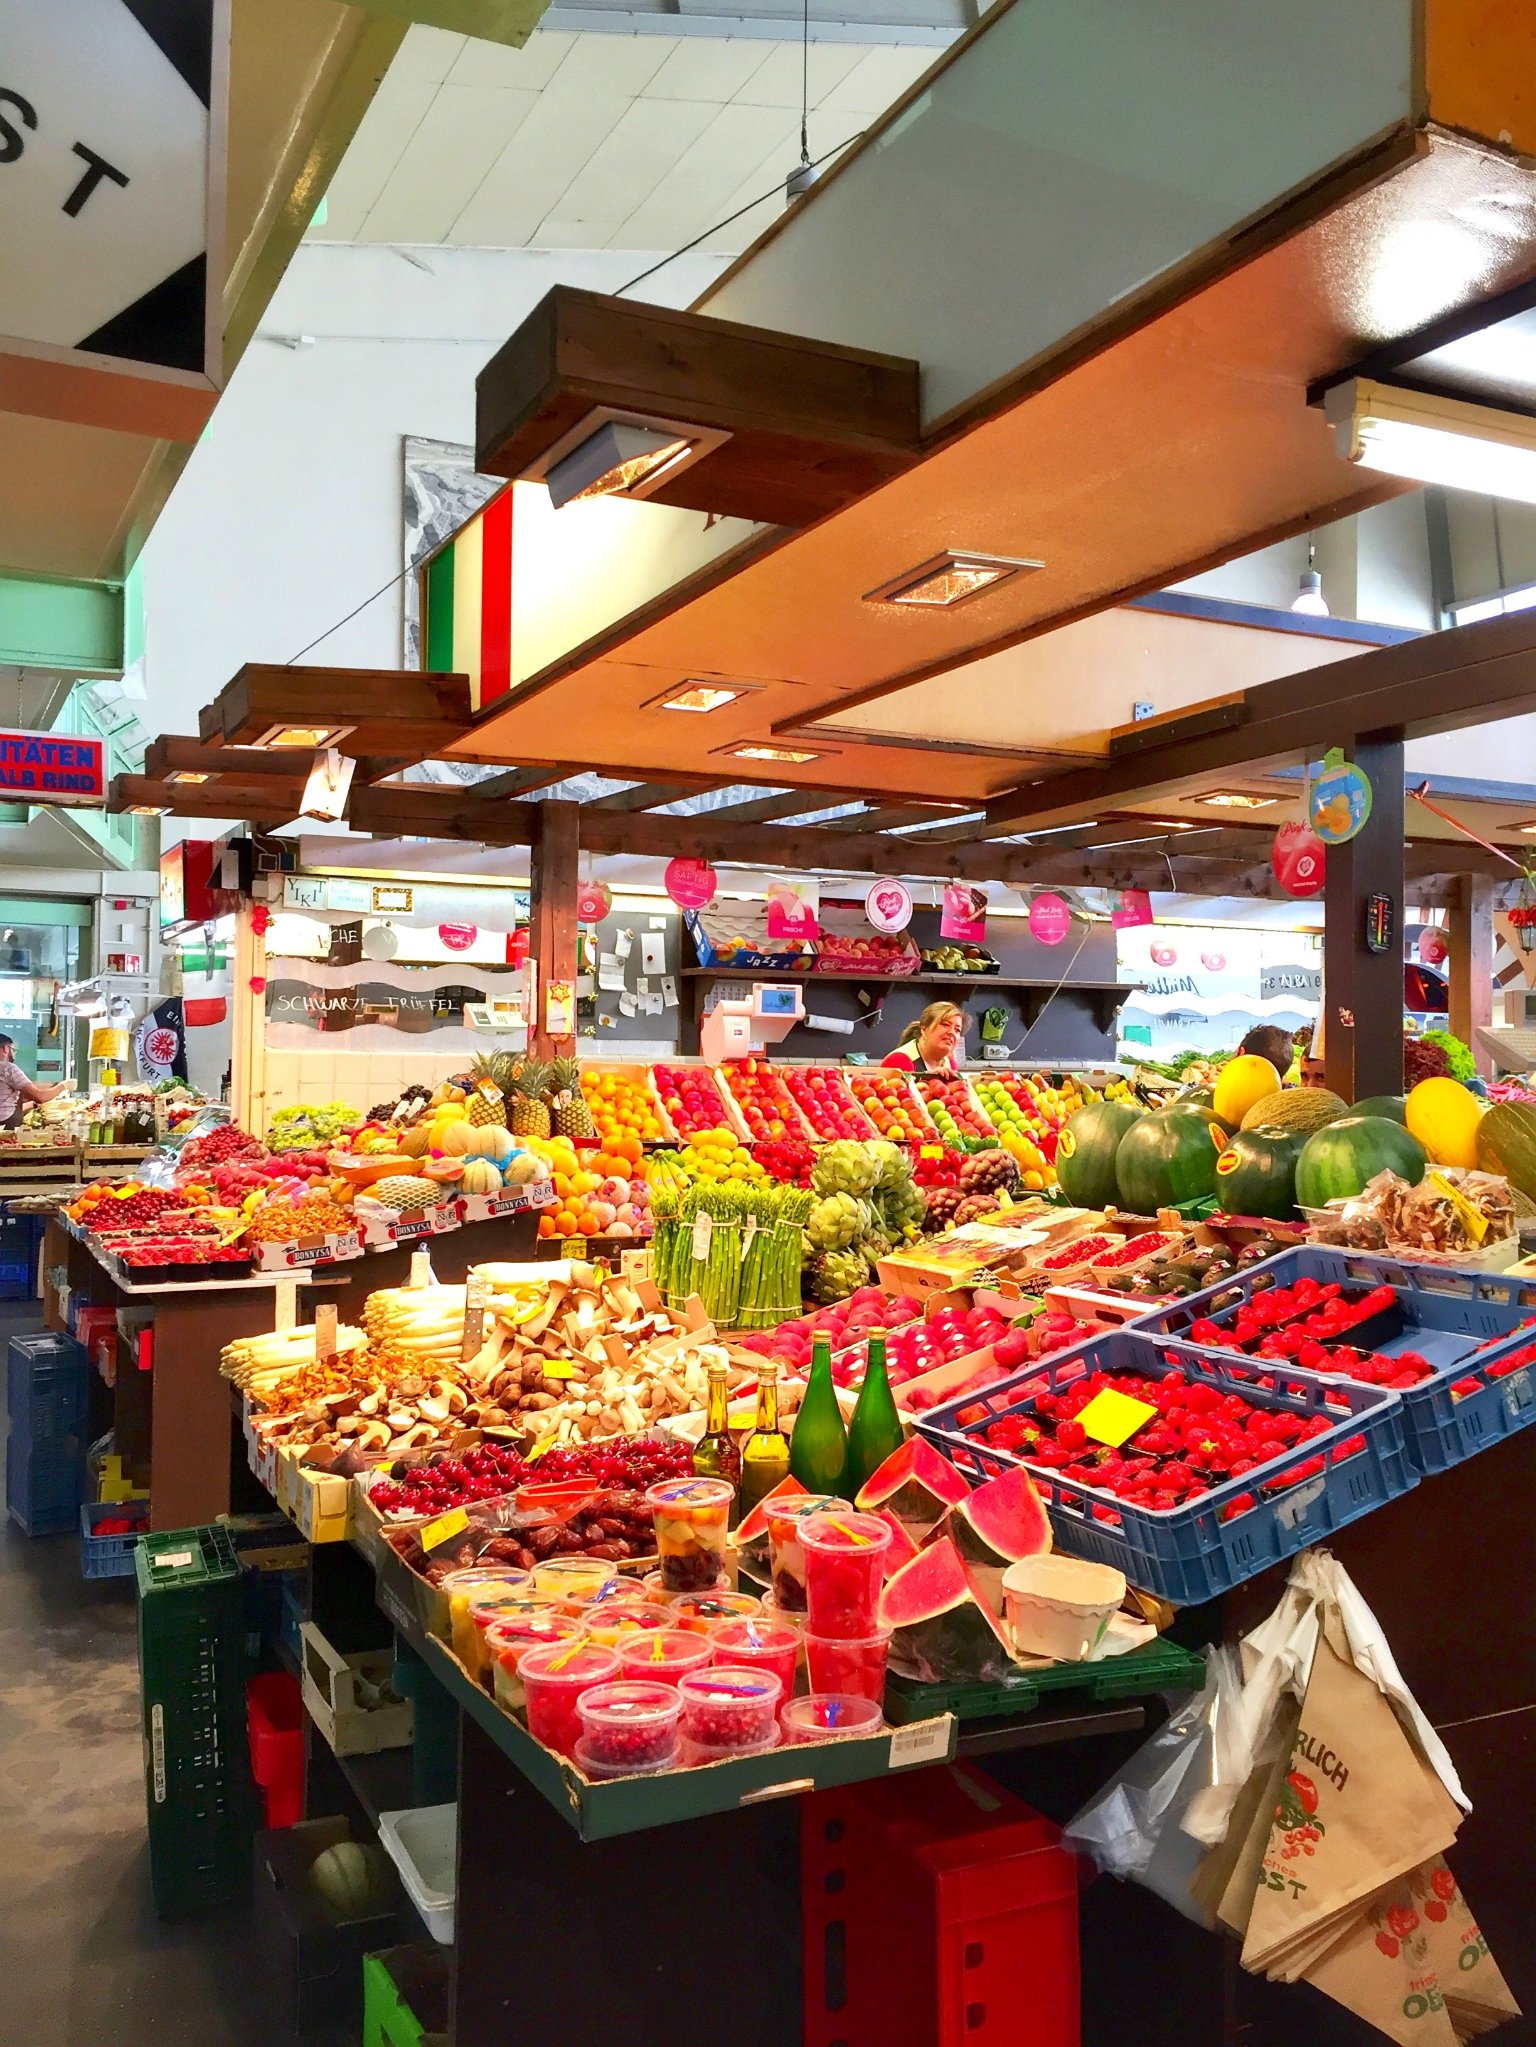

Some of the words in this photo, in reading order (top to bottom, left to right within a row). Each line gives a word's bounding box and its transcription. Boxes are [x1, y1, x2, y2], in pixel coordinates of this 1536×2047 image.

[43, 769, 95, 791] RIND
[746, 956, 778, 967] JAZZ
[495, 1197, 529, 1212] BONNYSA
[396, 1221, 431, 1236] BONNYSA
[294, 1247, 331, 1261] BONNYSA
